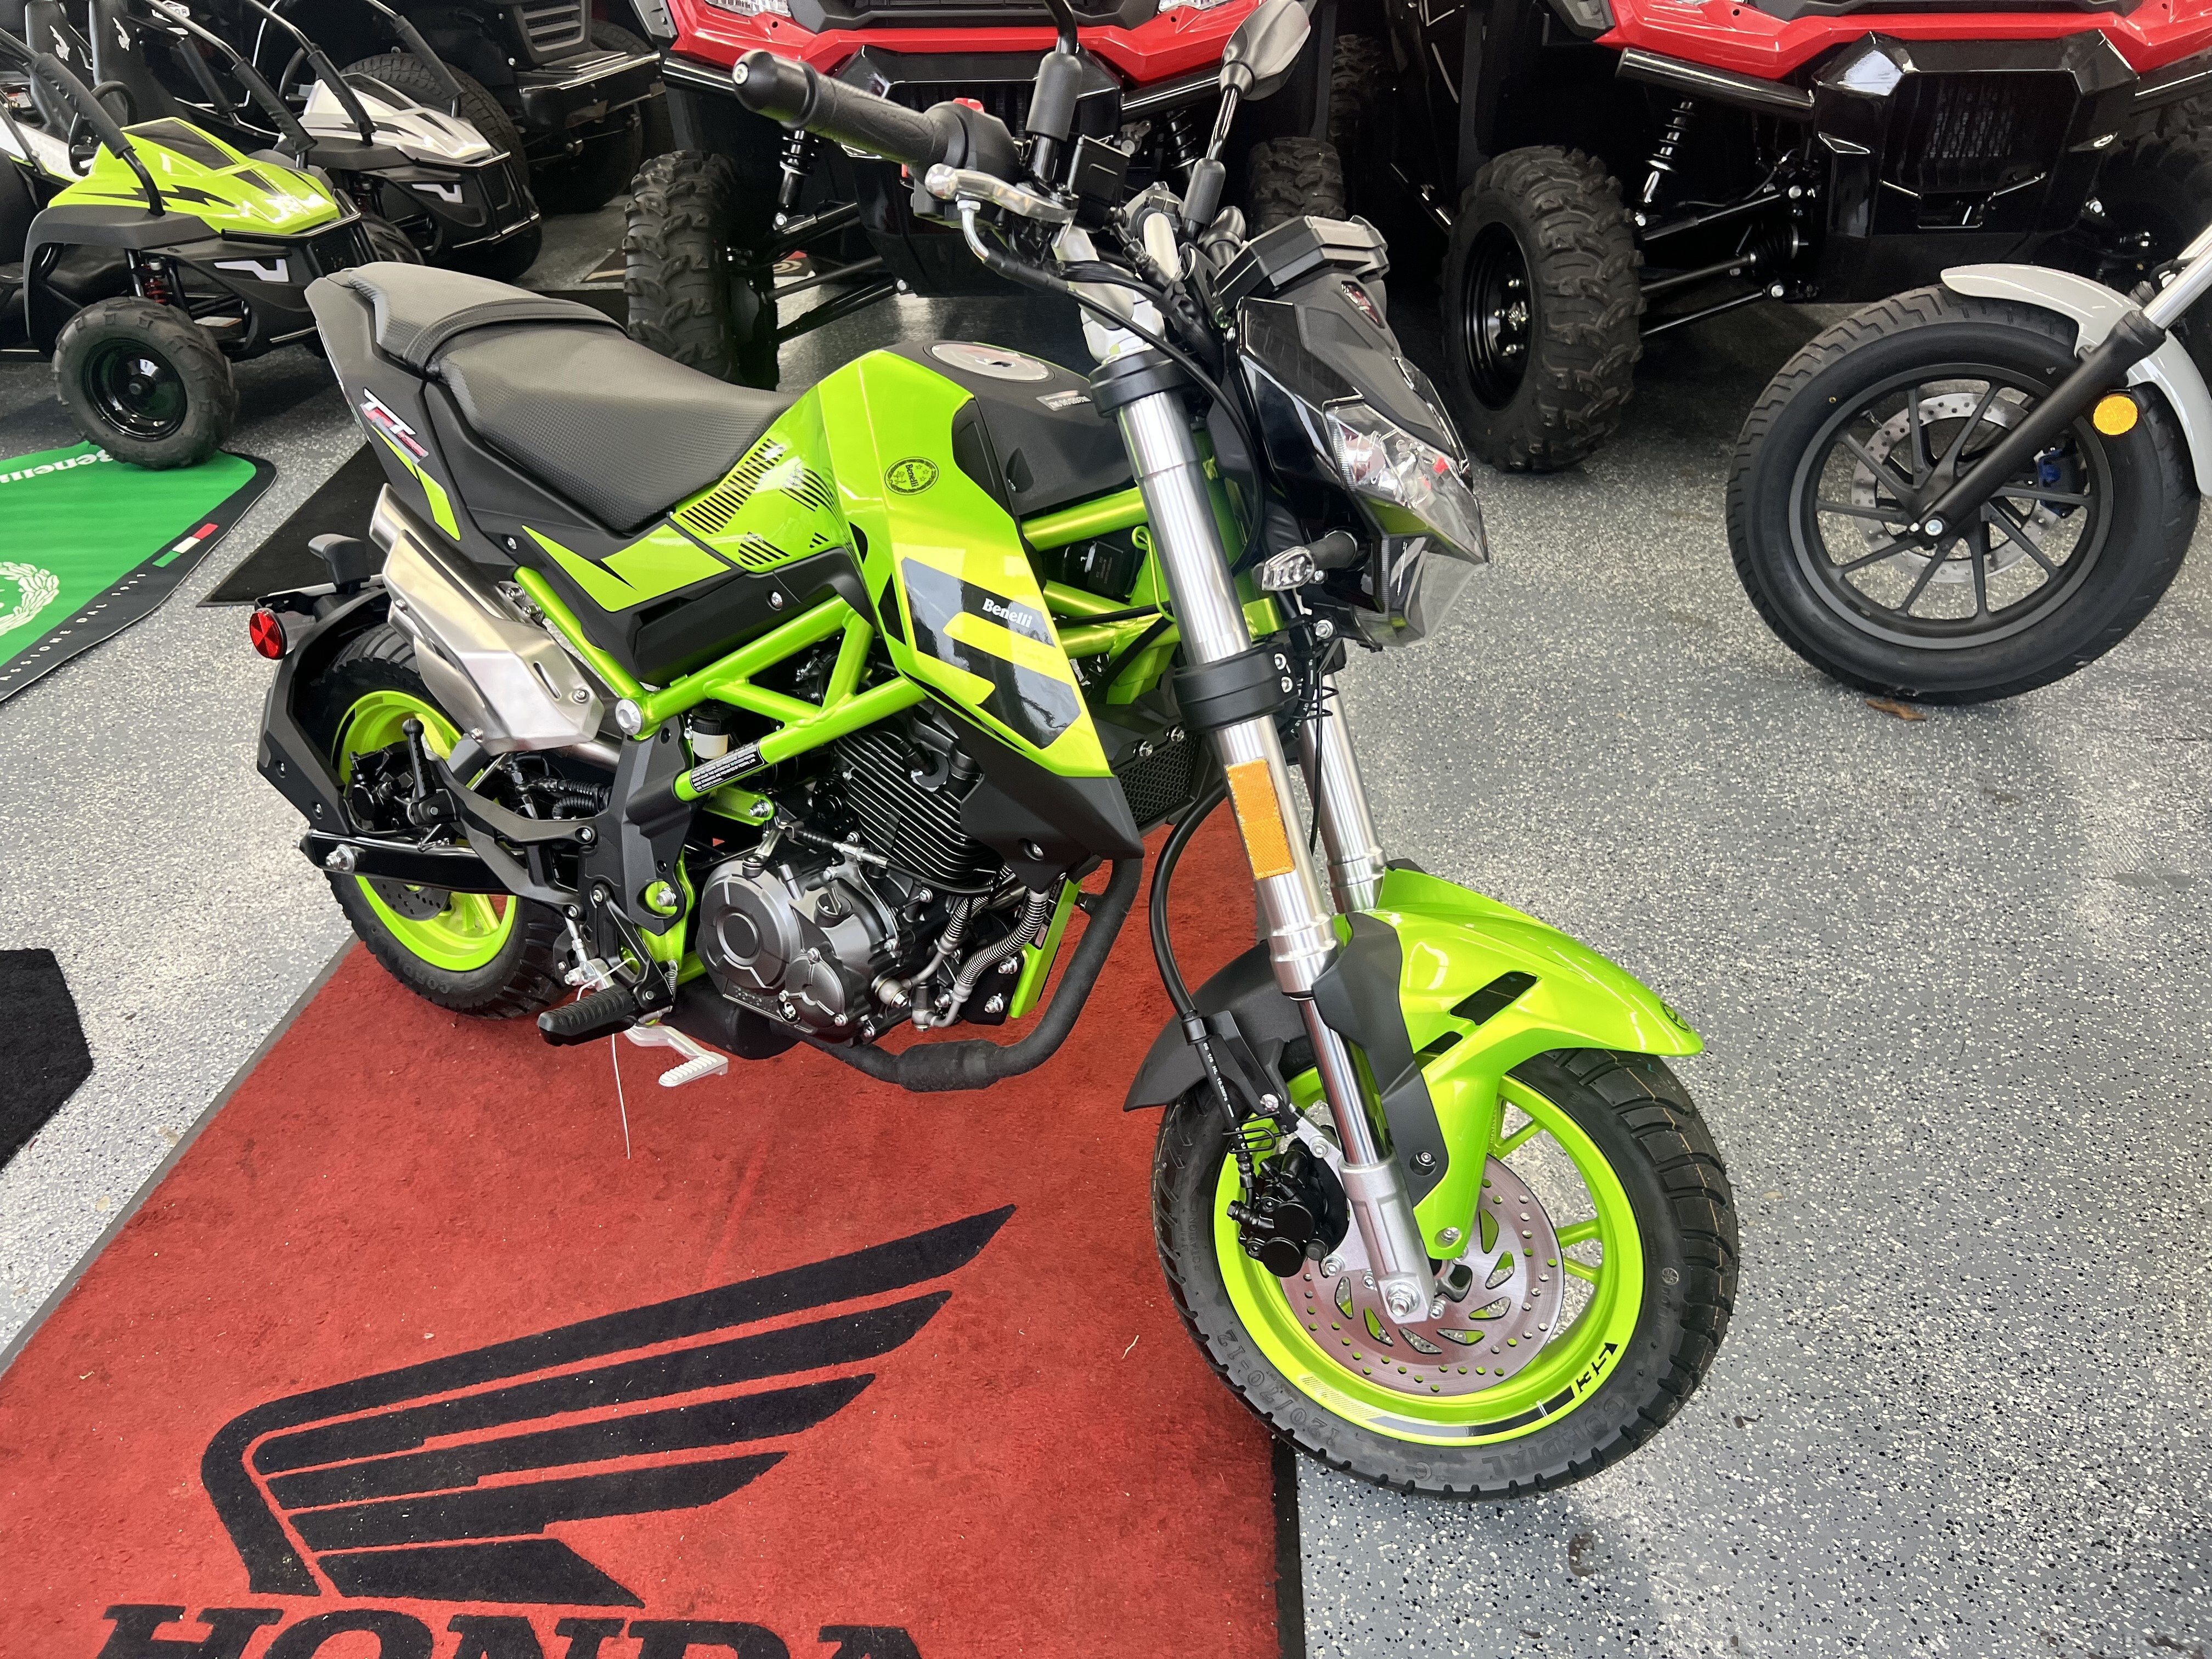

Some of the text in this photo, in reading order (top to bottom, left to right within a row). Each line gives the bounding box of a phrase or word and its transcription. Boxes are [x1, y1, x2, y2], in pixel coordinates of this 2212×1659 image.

[905, 464, 919, 487] Benelli
[76, 603, 107, 623] DAL
[982, 597, 1032, 628] Benelli
[1191, 1217, 1201, 1271] ROTATION
[1217, 1328, 1340, 1447] 120/70-12
[1482, 1395, 1626, 1477] CORDIAL
